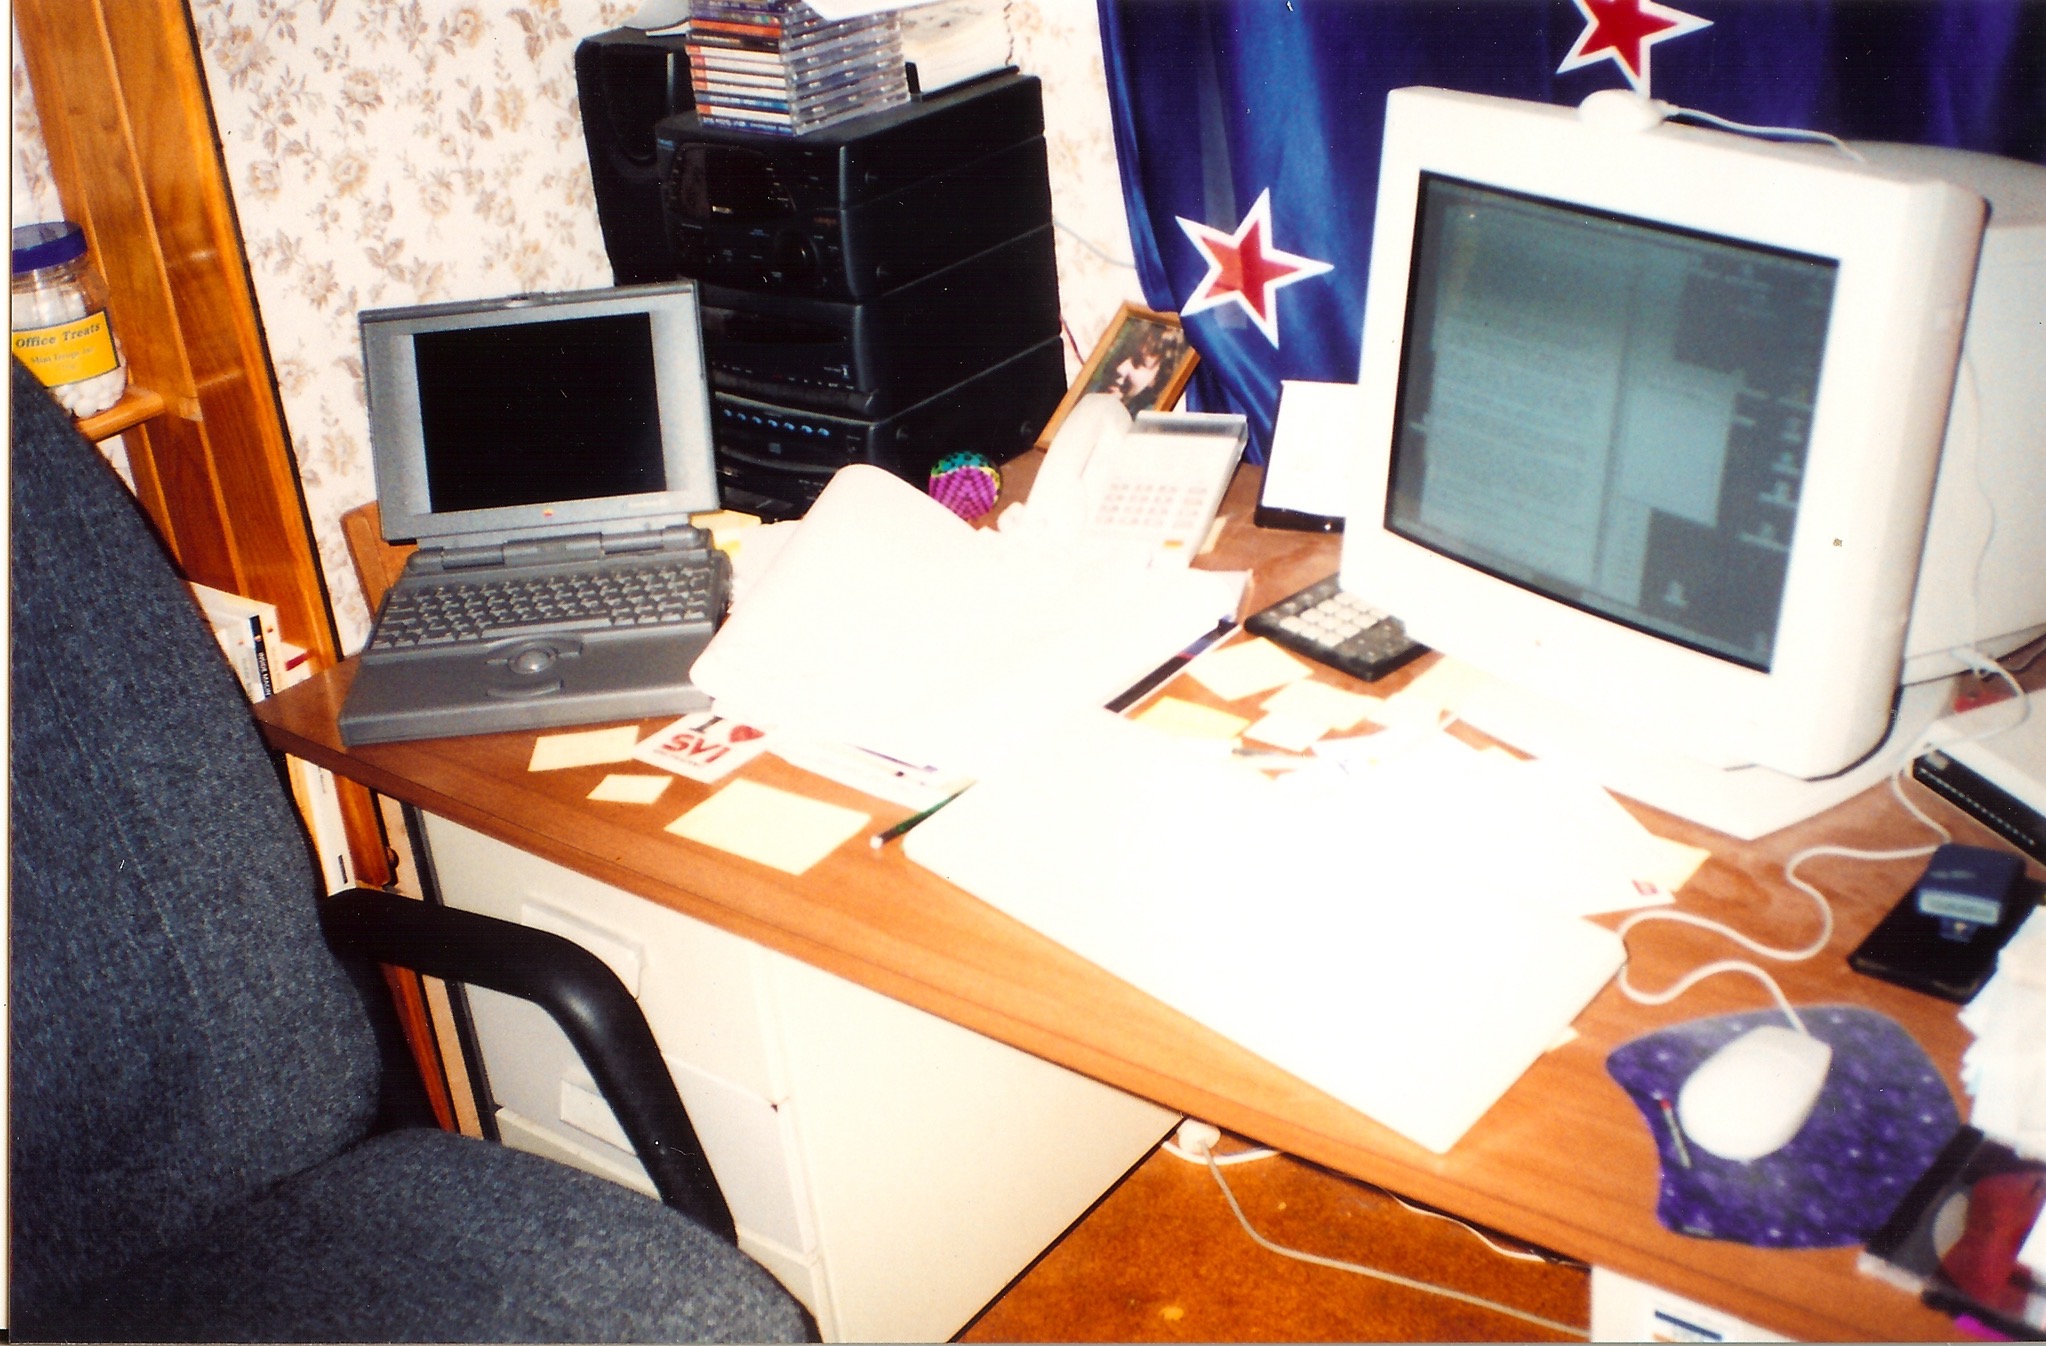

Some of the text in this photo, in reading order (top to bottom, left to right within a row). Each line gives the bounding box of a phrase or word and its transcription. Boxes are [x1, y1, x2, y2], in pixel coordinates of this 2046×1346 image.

[15, 323, 101, 348] Office Treats
[689, 715, 724, 733] I
[662, 733, 731, 764] SVI
